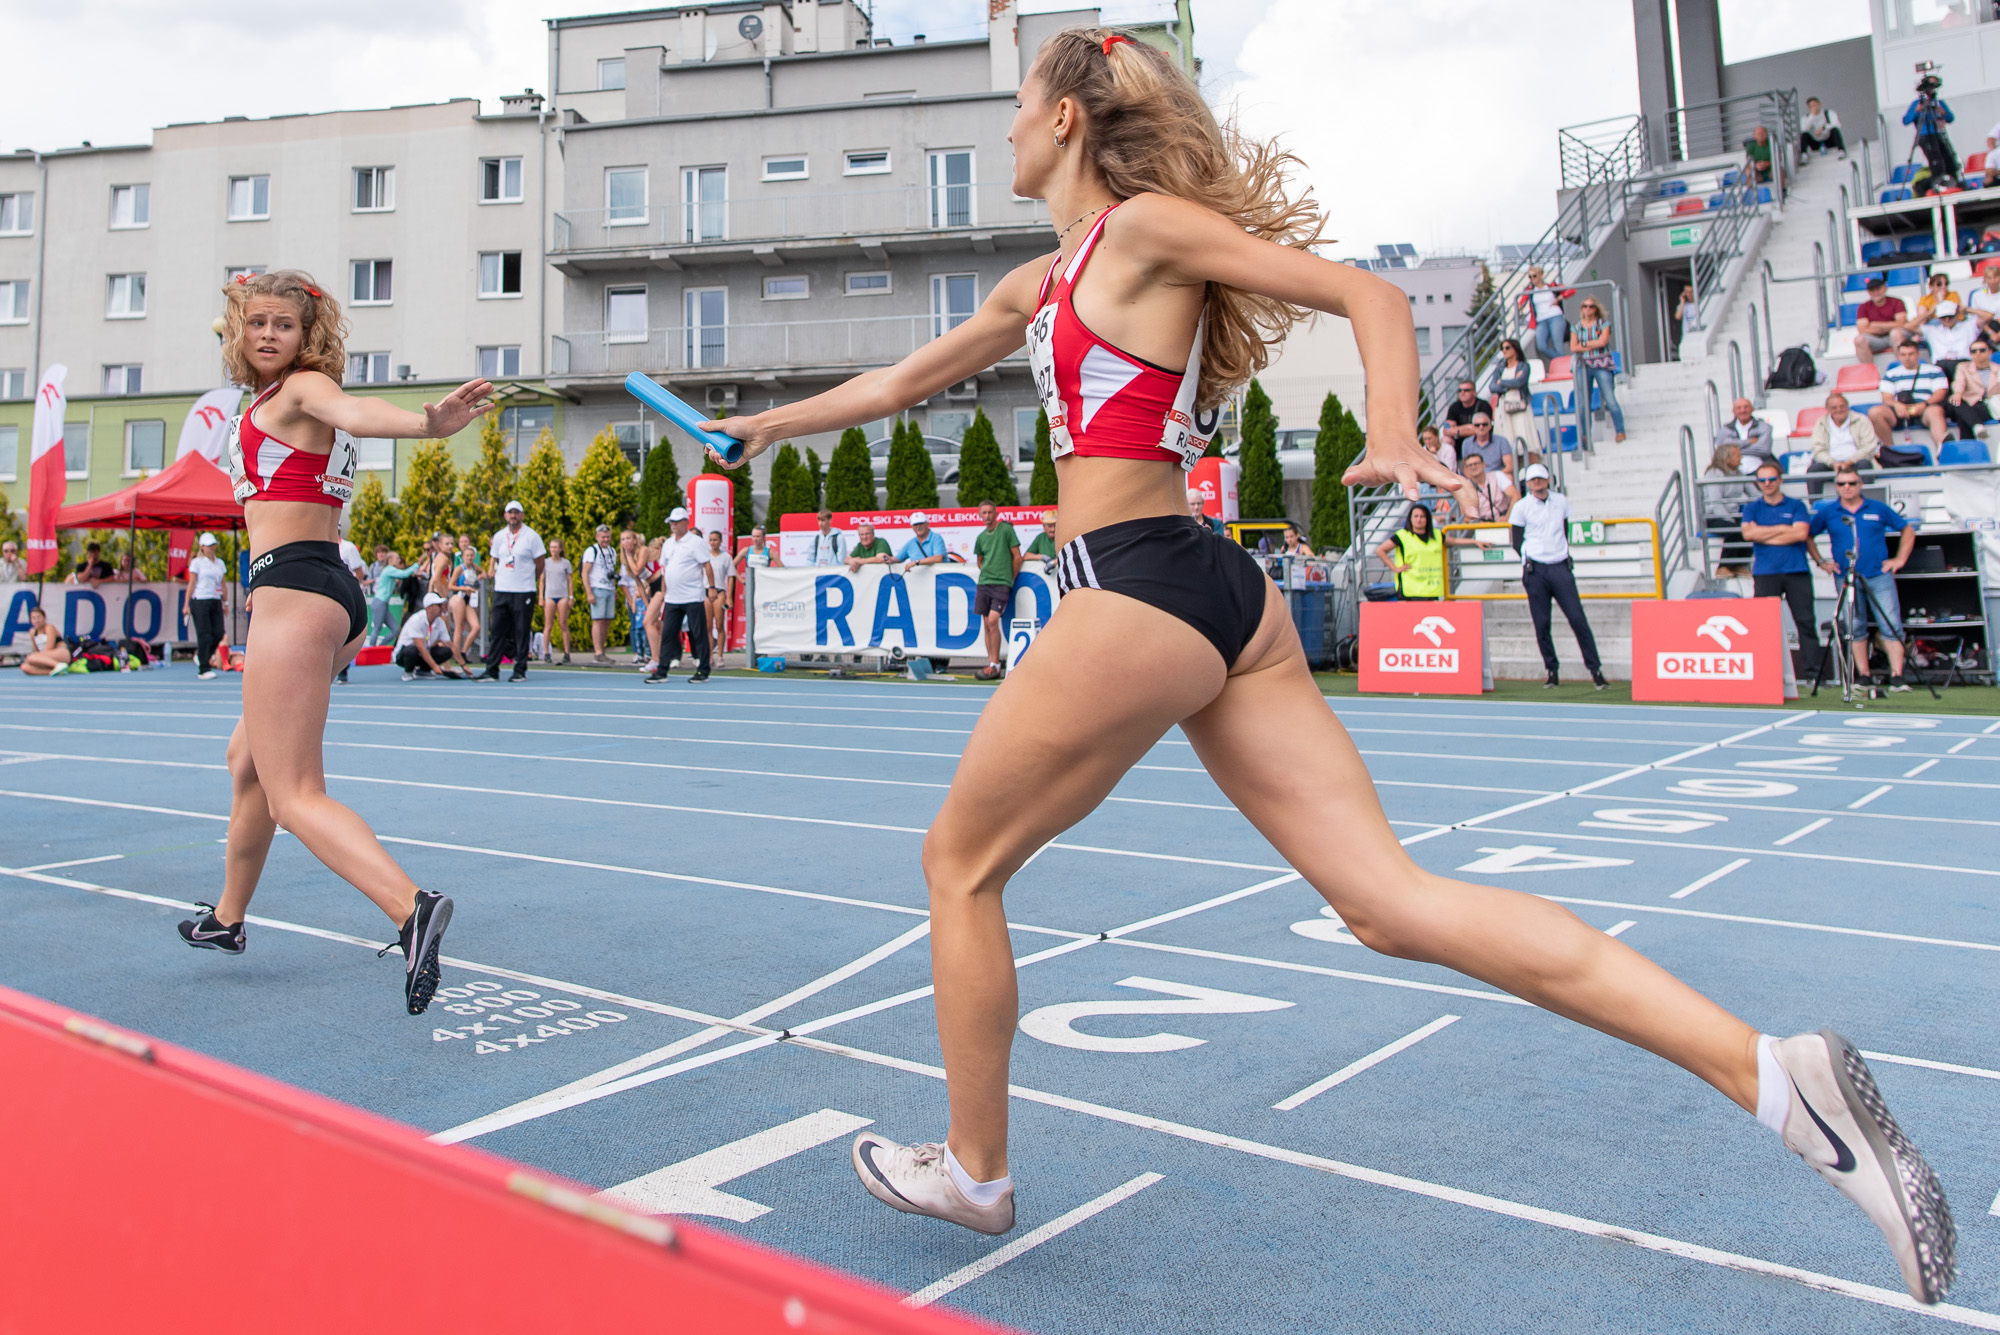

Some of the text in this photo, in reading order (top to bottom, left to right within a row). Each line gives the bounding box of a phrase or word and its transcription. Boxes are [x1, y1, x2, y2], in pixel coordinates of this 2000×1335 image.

[849, 515, 892, 525] POLSKI
[893, 513, 946, 524] ZWZEK
[996, 510, 1046, 521] ATLETYK
[1571, 522, 1604, 544] A-9
[252, 553, 274, 576] PRO
[1014, 630, 1031, 667] 2
[1384, 653, 1453, 668] ORLEN
[1663, 657, 1746, 674] ORLEN
[1735, 755, 1845, 772] 7
[1577, 808, 1729, 834] 5
[1455, 844, 1635, 874] 4
[443, 989, 541, 1016] 800
[1018, 975, 1297, 1053] 2
[432, 999, 583, 1042] 4x100
[475, 1010, 628, 1055] 4x400
[592, 1108, 874, 1224] 1
